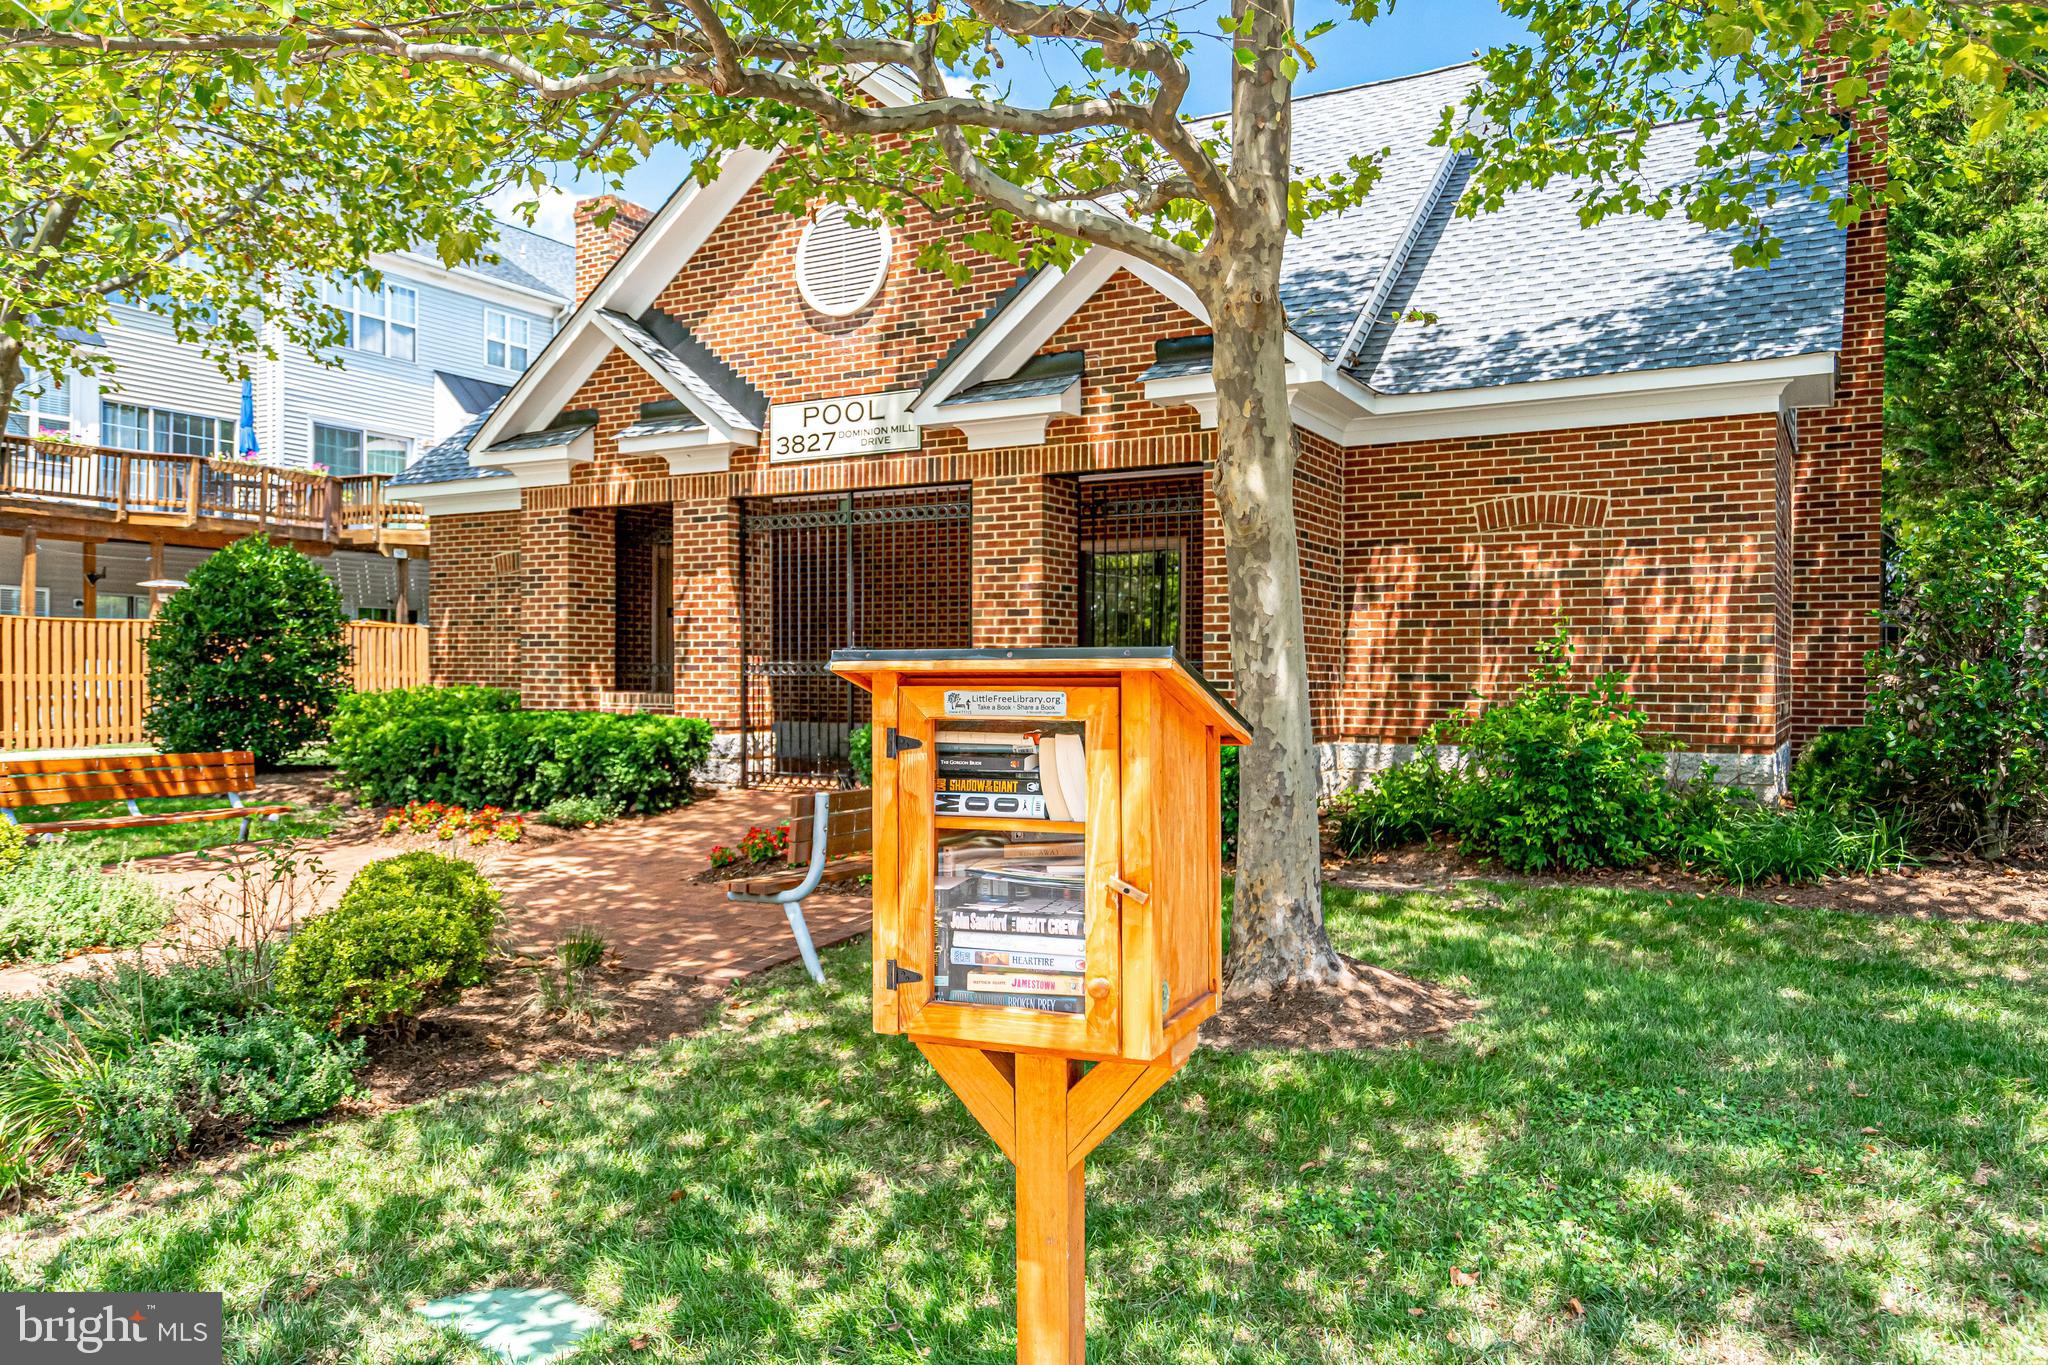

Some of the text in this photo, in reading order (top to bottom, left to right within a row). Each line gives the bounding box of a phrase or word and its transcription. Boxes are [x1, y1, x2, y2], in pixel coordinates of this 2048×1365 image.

[803, 400, 885, 427] POOL
[838, 424, 914, 439] DOMINION MILL
[776, 432, 836, 455] 3827
[861, 436, 891, 446] DRIVE
[971, 695, 1061, 705] LittleFreeLibrary.org
[950, 779, 985, 792] SHADOW
[993, 781, 1018, 793] GIANT
[950, 911, 970, 929] John
[970, 912, 1007, 931] Sandford
[1016, 917, 1047, 934] NIGHT
[1047, 919, 1079, 935] CREW
[1012, 955, 1055, 967] HEARTFIRE
[1011, 978, 1056, 990] JAMESTOWN
[1008, 995, 1034, 1009] BROKEN
[1037, 998, 1056, 1011] PREY
